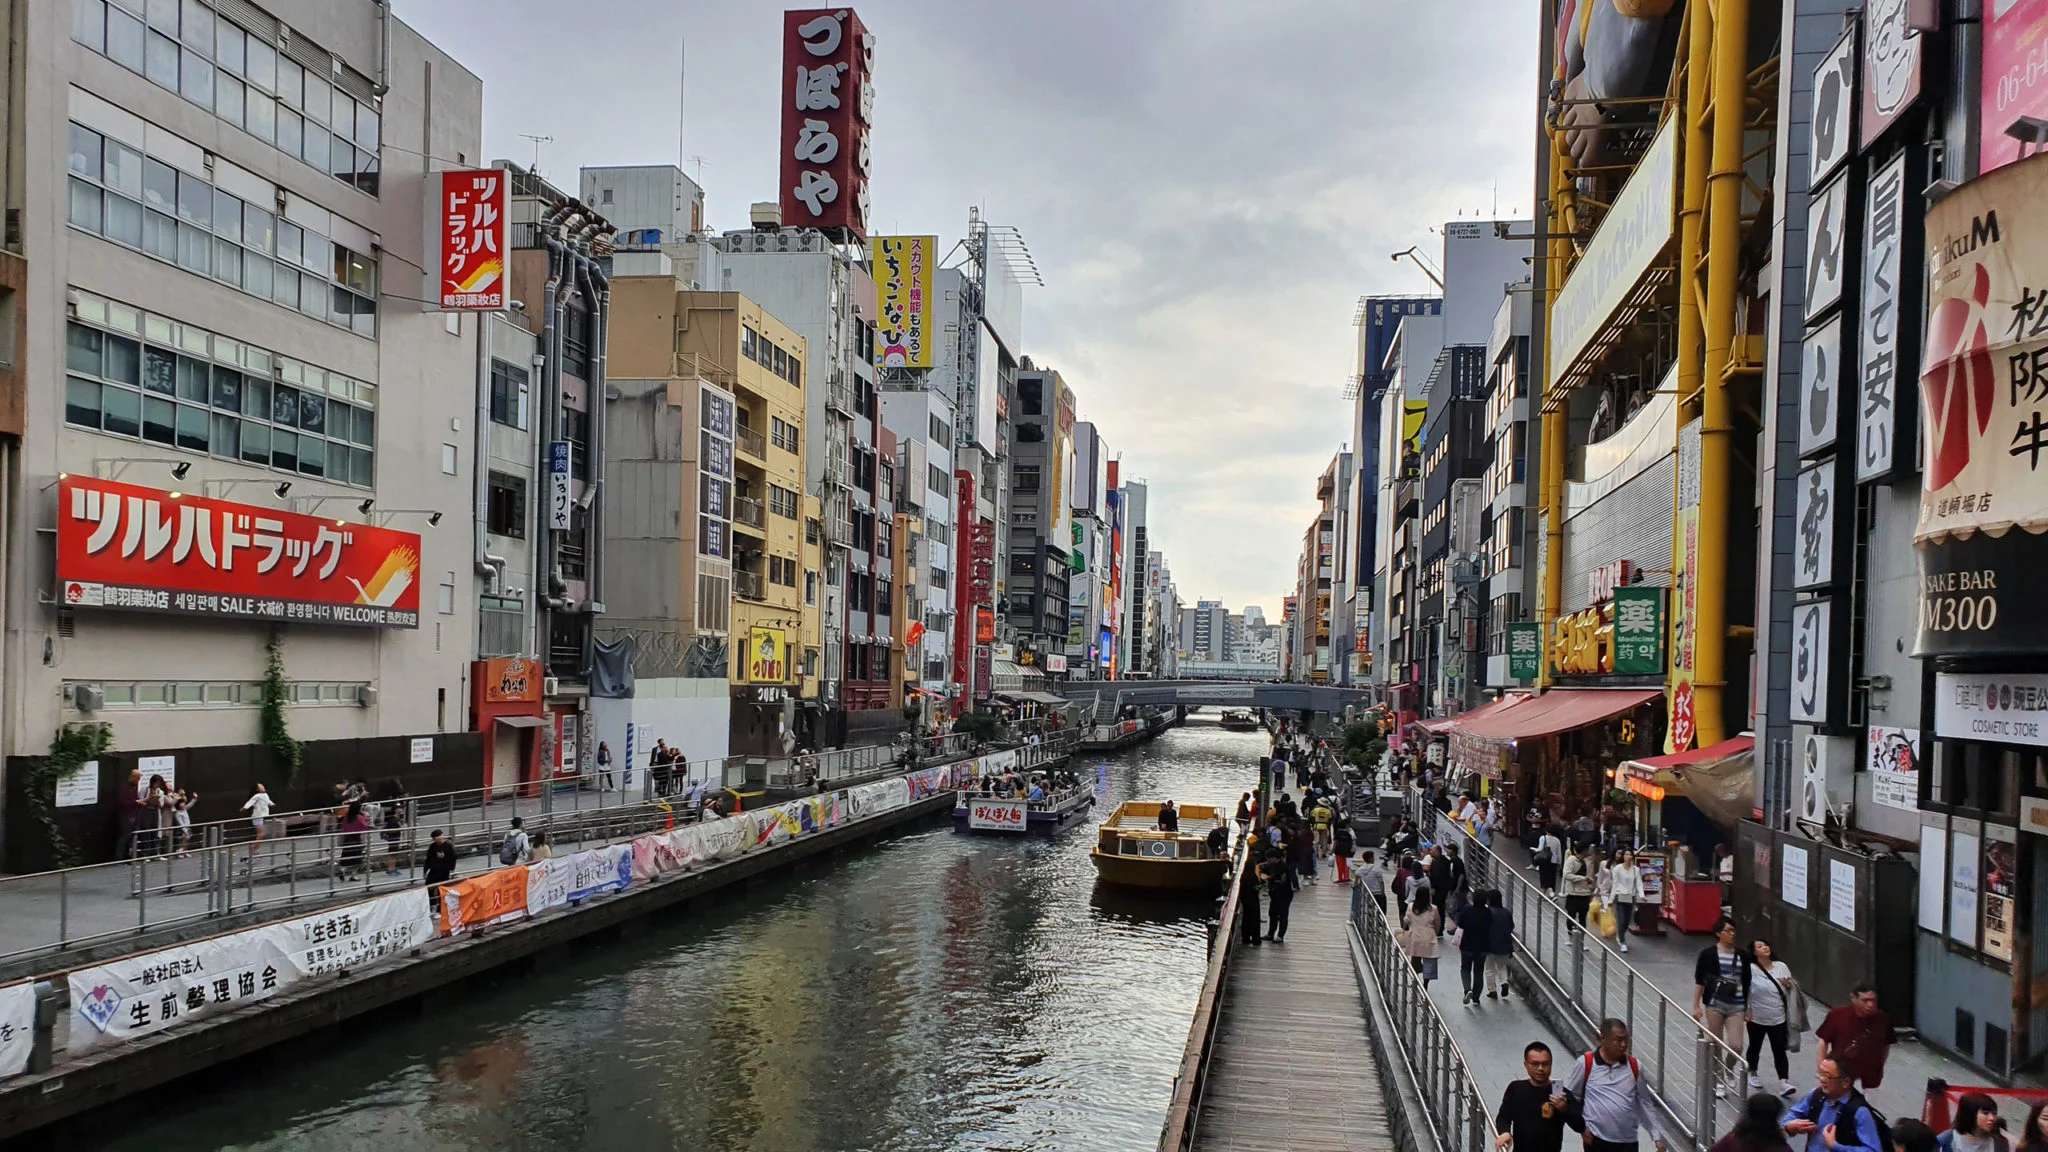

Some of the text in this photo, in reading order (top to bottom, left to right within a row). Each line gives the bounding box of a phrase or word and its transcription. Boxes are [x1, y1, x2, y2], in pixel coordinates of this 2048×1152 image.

[793, 10, 848, 217] づぼらや
[471, 177, 498, 253] ツルハ
[447, 191, 470, 274] ドラッグ
[882, 239, 906, 345] いちごなび
[909, 239, 922, 363] スカウト機能もあるて
[1864, 169, 1899, 468] 旨くて安い
[555, 446, 567, 471] 焼肉
[555, 475, 567, 527] いろりや
[1937, 492, 1993, 518] 道頓堀店
[71, 487, 354, 580] ツルハドラッグ
[1927, 570, 1997, 593] SAKE BAR
[221, 596, 254, 614] SALE
[287, 603, 330, 620] 환영합니다
[333, 606, 385, 624] WELCOME
[1619, 599, 1655, 633] 薬
[1924, 596, 1997, 632] M300
[1512, 630, 1536, 652] 薬
[1618, 644, 1656, 660] 药 약
[1973, 719, 2039, 737] COSMETIC STORE
[975, 805, 1022, 824] ぽんぽん船
[304, 914, 359, 944] 『生き活』
[128, 955, 204, 986] 一般社団法人
[128, 964, 278, 1029] 生前整理協会
